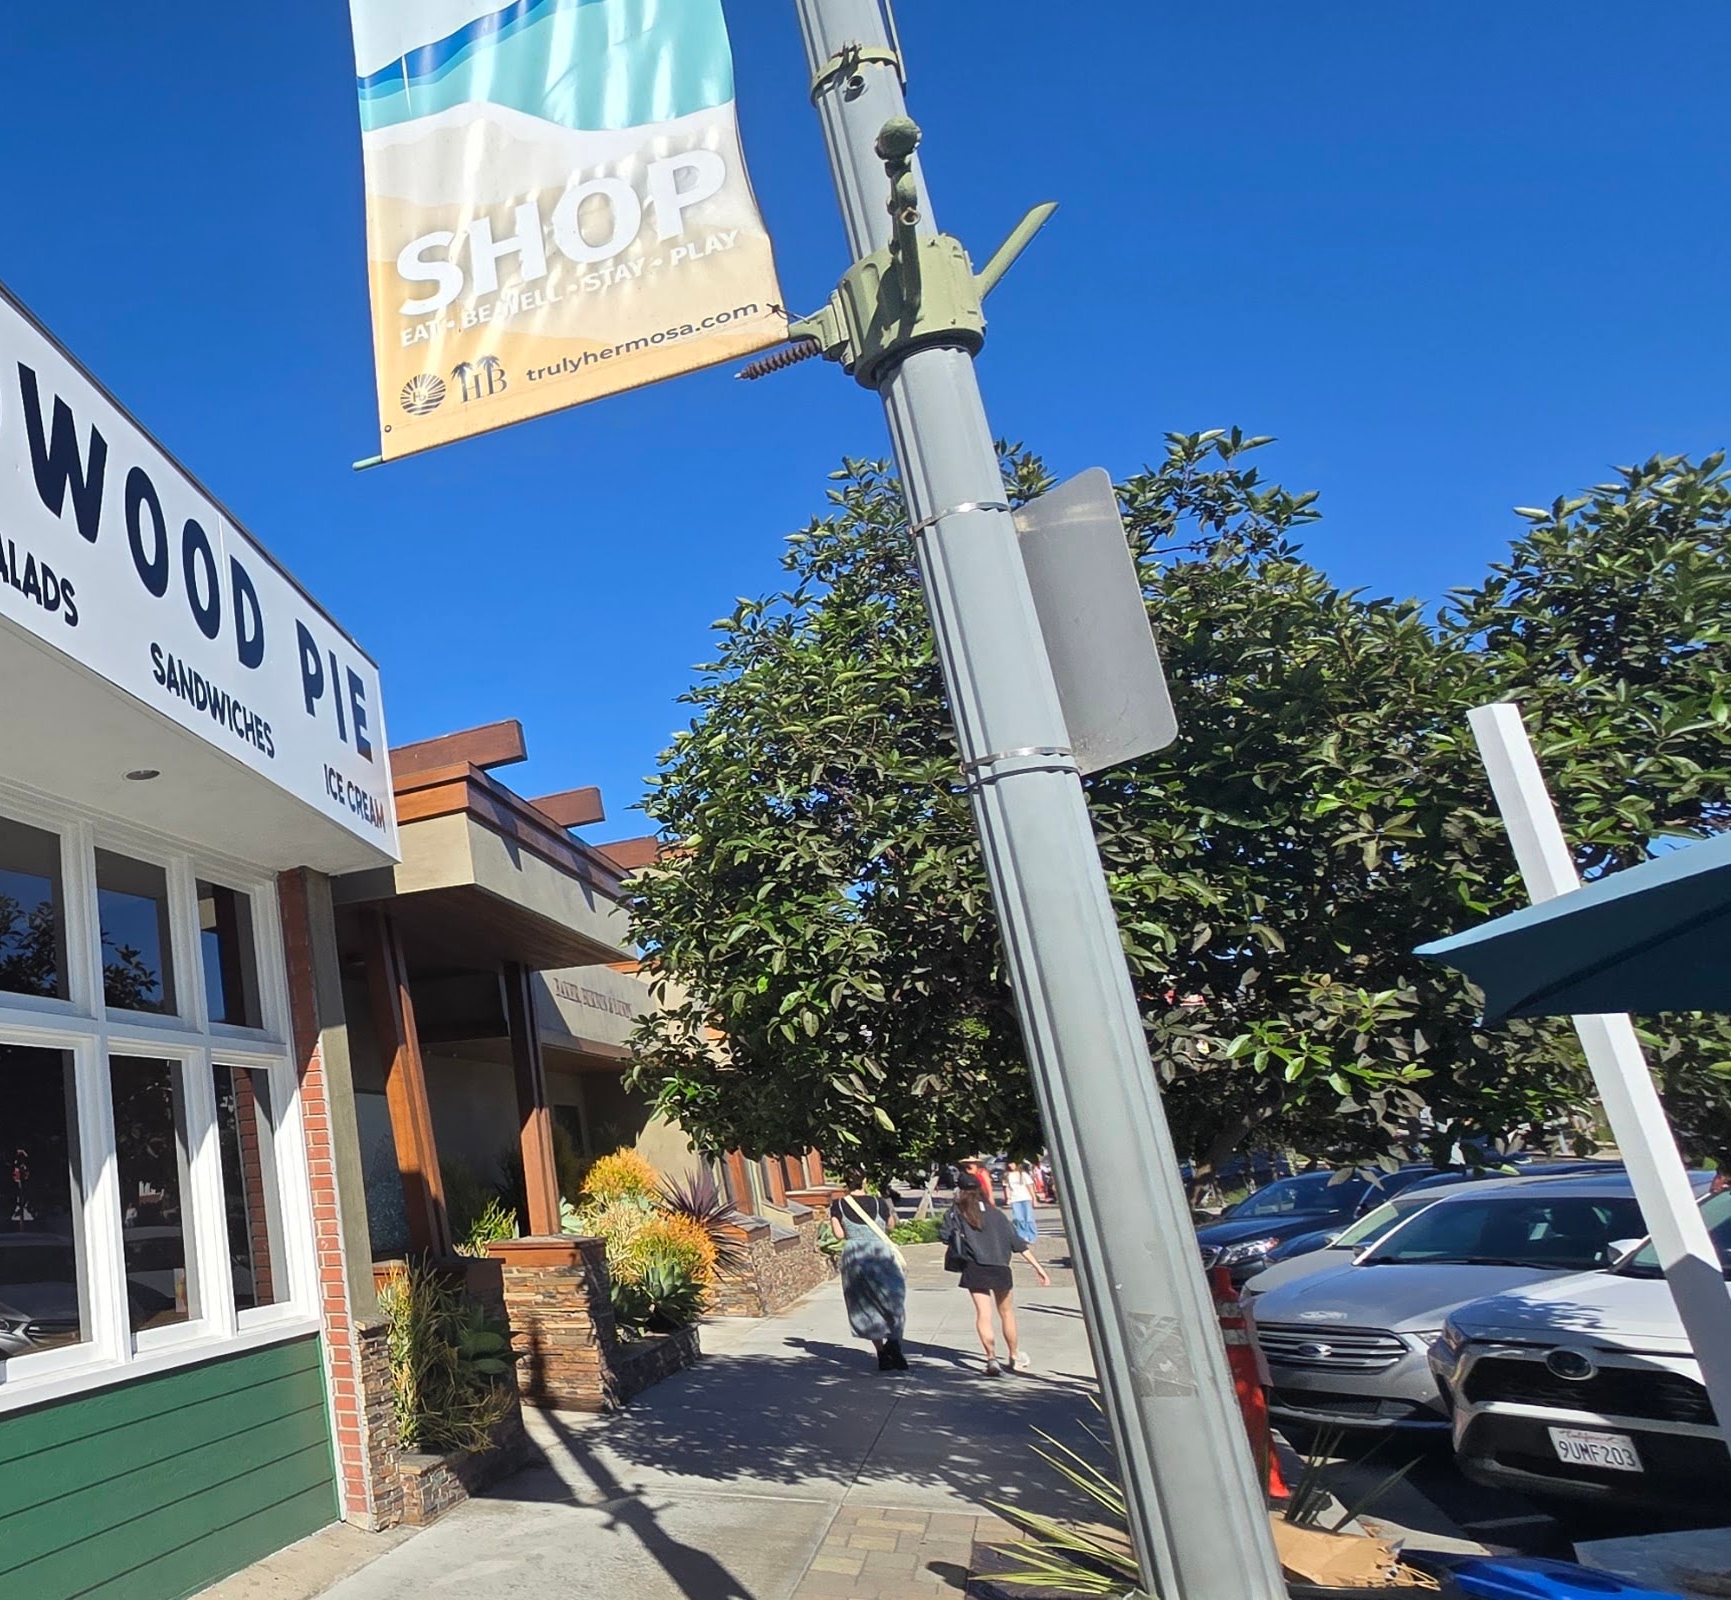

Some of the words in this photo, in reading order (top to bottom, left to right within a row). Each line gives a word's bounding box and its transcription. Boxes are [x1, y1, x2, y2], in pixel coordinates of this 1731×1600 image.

[396, 149, 726, 317] SHOP
[401, 318, 445, 347] EAT
[462, 304, 491, 330] BE
[495, 285, 564, 317] WELL
[583, 257, 645, 292] STAY
[670, 229, 739, 265] PLAY
[526, 303, 759, 381] trulyhermosa.com
[150, 641, 276, 760] SANDWICHES
[296, 619, 374, 764] PIE
[323, 763, 345, 806] ICE
[347, 780, 387, 834] CREAM
